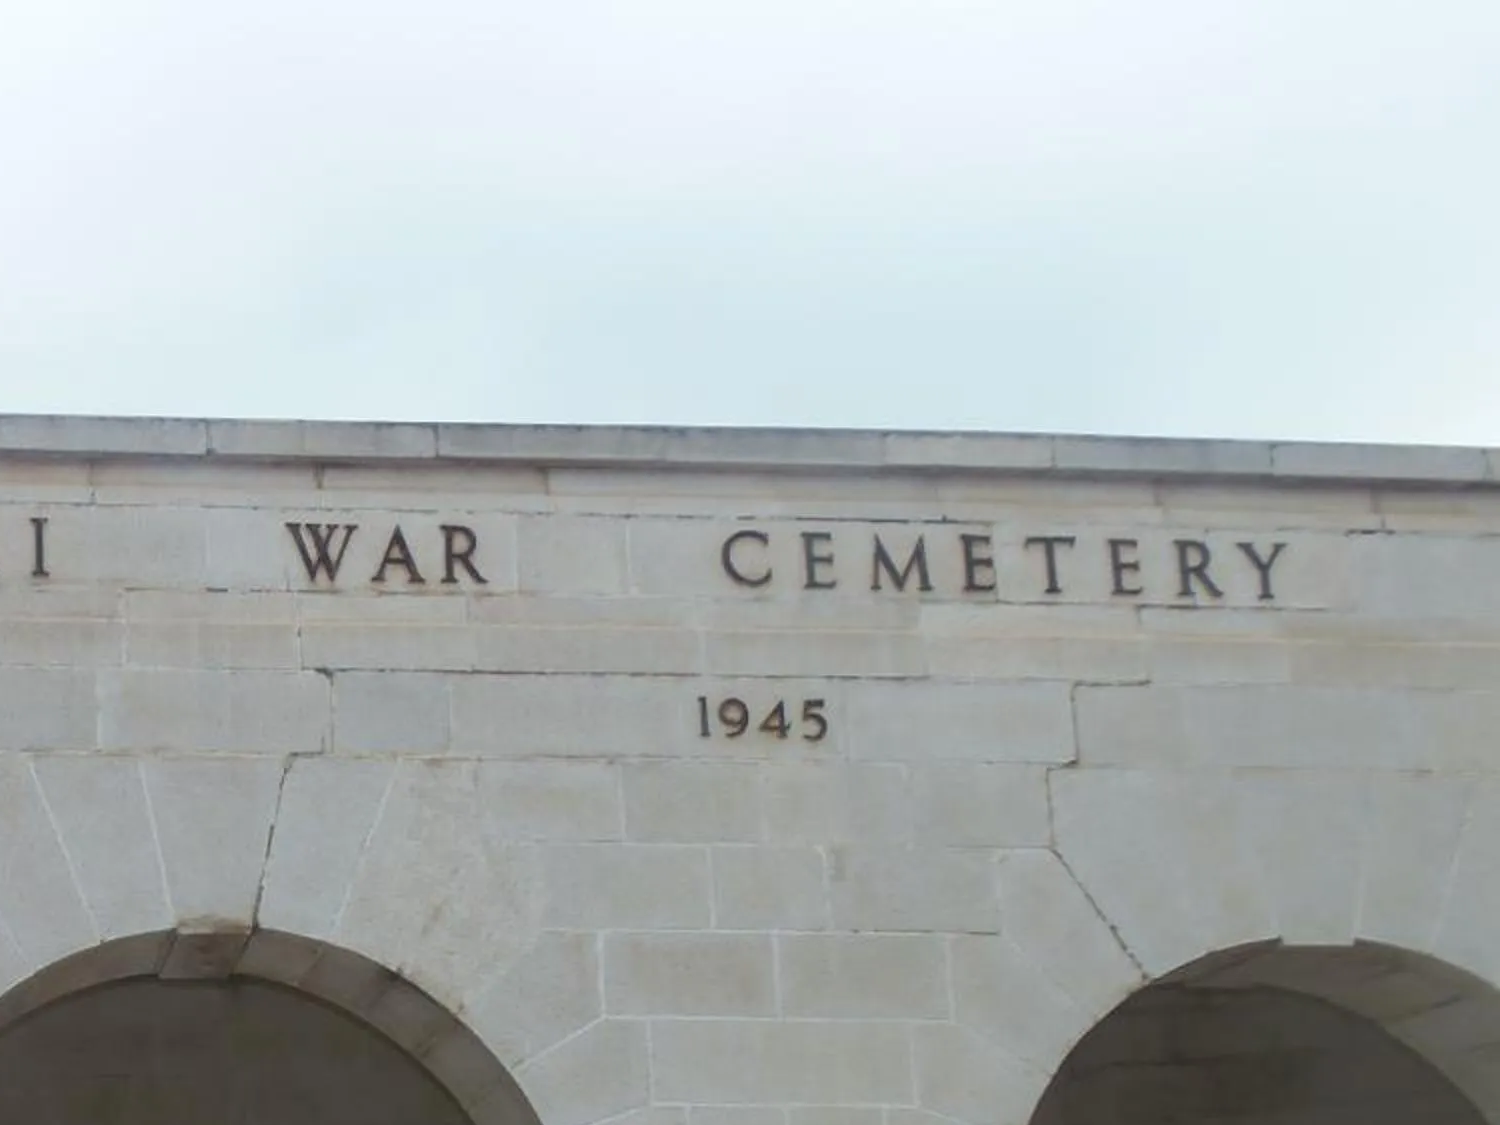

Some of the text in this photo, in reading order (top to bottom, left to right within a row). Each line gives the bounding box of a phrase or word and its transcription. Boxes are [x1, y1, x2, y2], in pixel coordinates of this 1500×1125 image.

[286, 521, 490, 585] WAR
[720, 530, 1288, 600] CEMETERY
[697, 695, 830, 742] 1945
